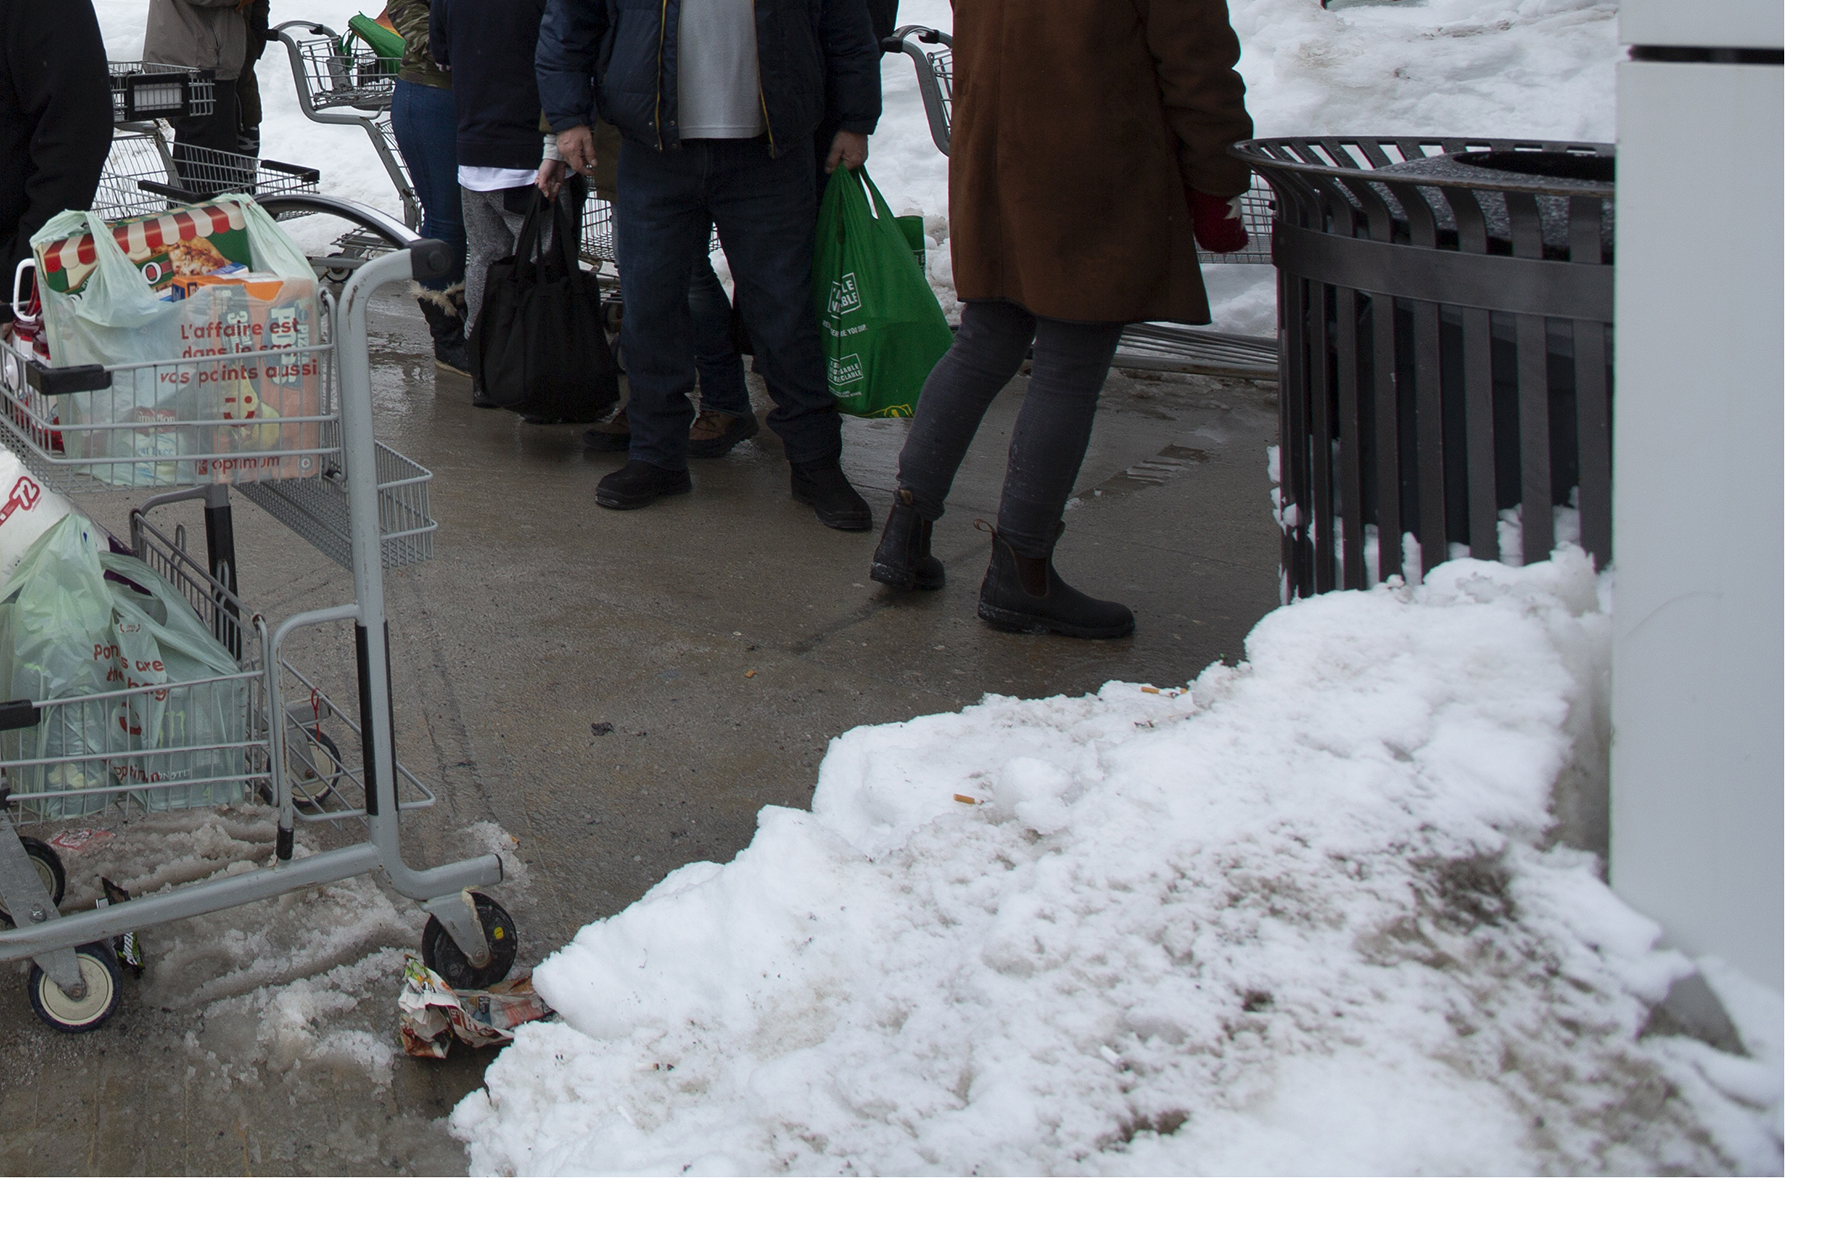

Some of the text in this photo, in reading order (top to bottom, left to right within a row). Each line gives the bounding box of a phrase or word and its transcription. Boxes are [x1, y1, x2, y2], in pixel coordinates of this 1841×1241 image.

[181, 319, 263, 340] L'affaire
[269, 317, 299, 334] est
[160, 371, 190, 385] vos
[198, 365, 259, 388] points
[212, 455, 280, 475] optimum
[10, 477, 39, 509] 72
